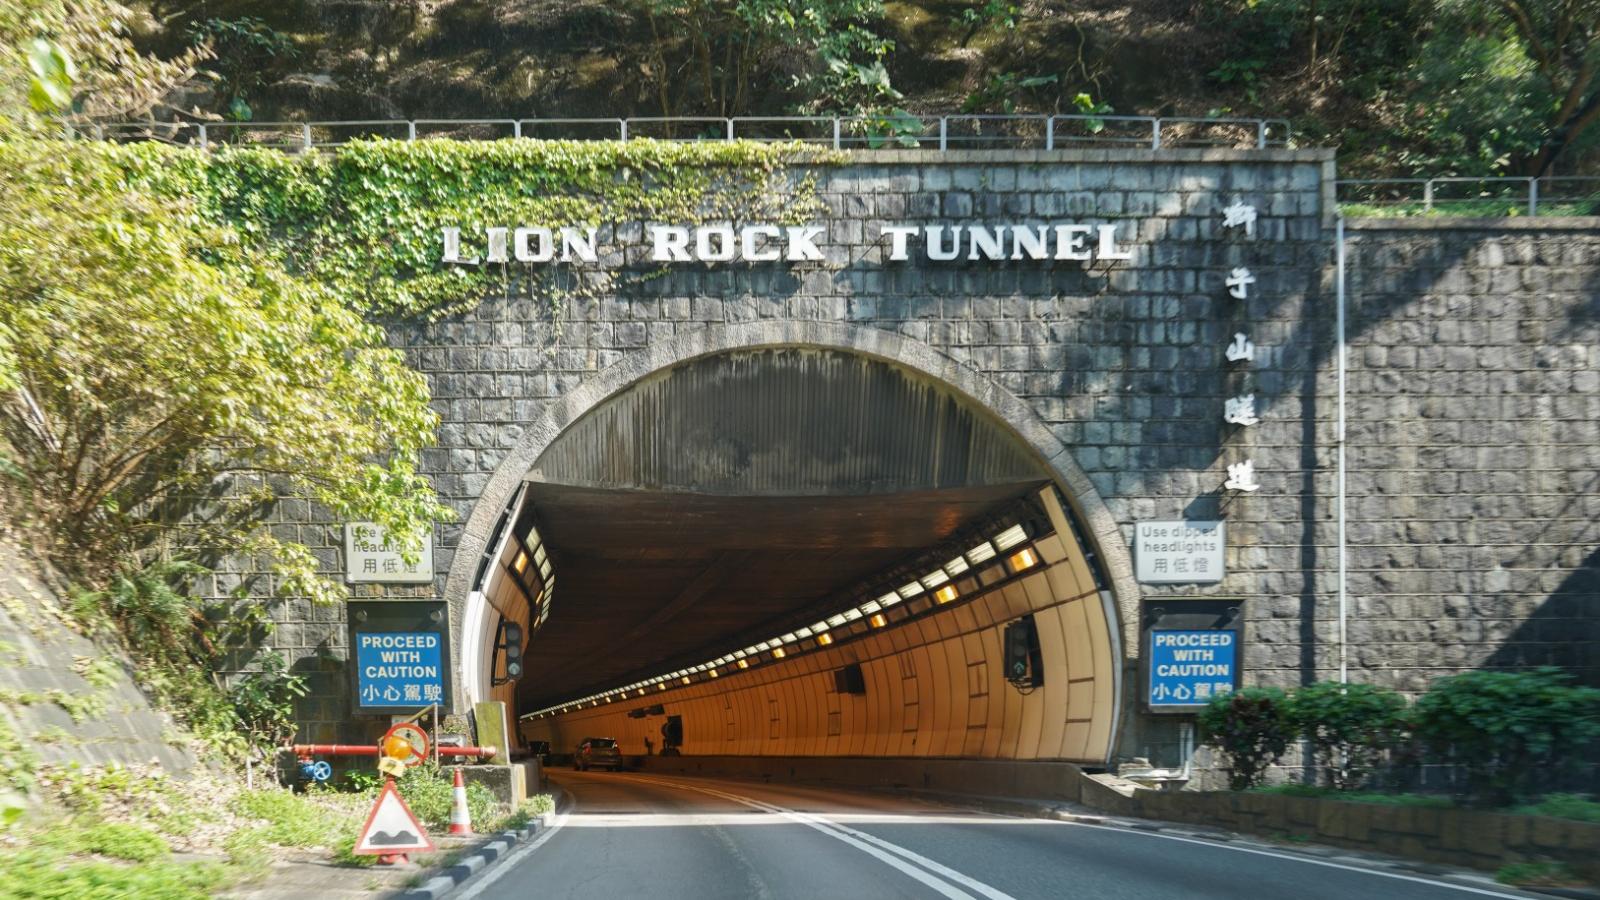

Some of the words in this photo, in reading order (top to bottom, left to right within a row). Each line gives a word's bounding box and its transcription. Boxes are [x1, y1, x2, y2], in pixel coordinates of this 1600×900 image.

[442, 226, 599, 265] LION
[650, 223, 826, 264] ROCK
[880, 223, 1133, 262] TUNNEL
[1222, 200, 1261, 492] 獅子山隧道
[1142, 525, 1168, 538] Use
[1171, 524, 1218, 540] dipped
[1143, 541, 1217, 554] headlights
[1152, 557, 1209, 574] 用低燈
[362, 636, 436, 649] PROCEED
[1155, 635, 1232, 647] PROCEED
[380, 651, 420, 663] WITH
[1173, 650, 1215, 661] WITH
[365, 666, 437, 679] CAUTION
[1157, 665, 1229, 677] CAUTION
[363, 684, 442, 702] 小心駕駛
